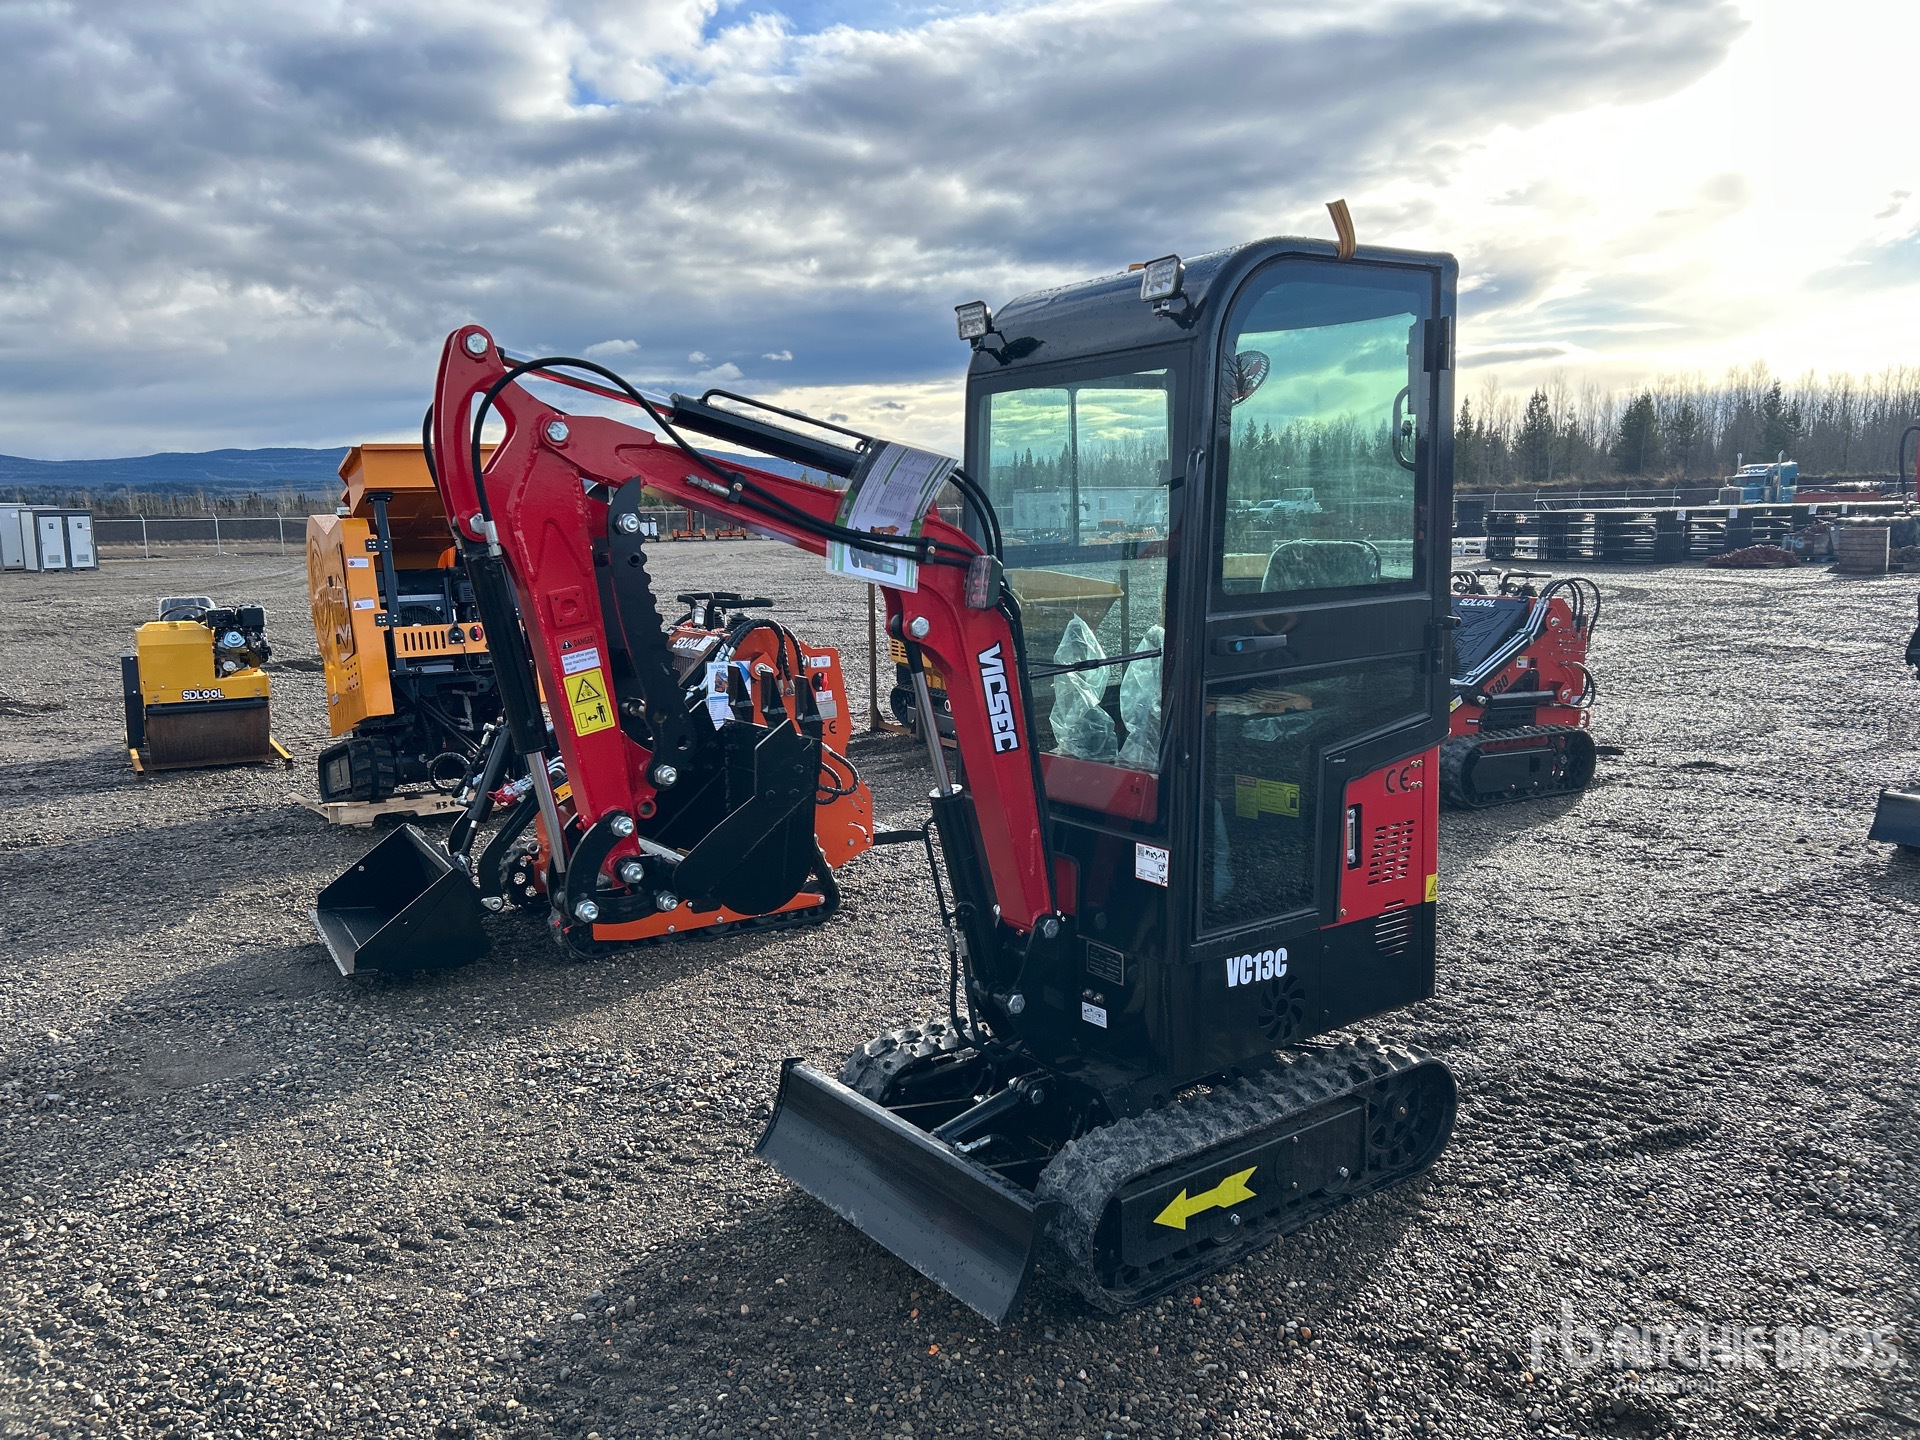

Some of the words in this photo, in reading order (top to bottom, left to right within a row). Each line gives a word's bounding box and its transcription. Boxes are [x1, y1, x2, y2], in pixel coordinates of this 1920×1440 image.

[1459, 598, 1496, 608] SDLOOL
[573, 635, 593, 646] DANGER
[182, 688, 225, 700] SDLOOL
[1226, 947, 1288, 988] VC13C
